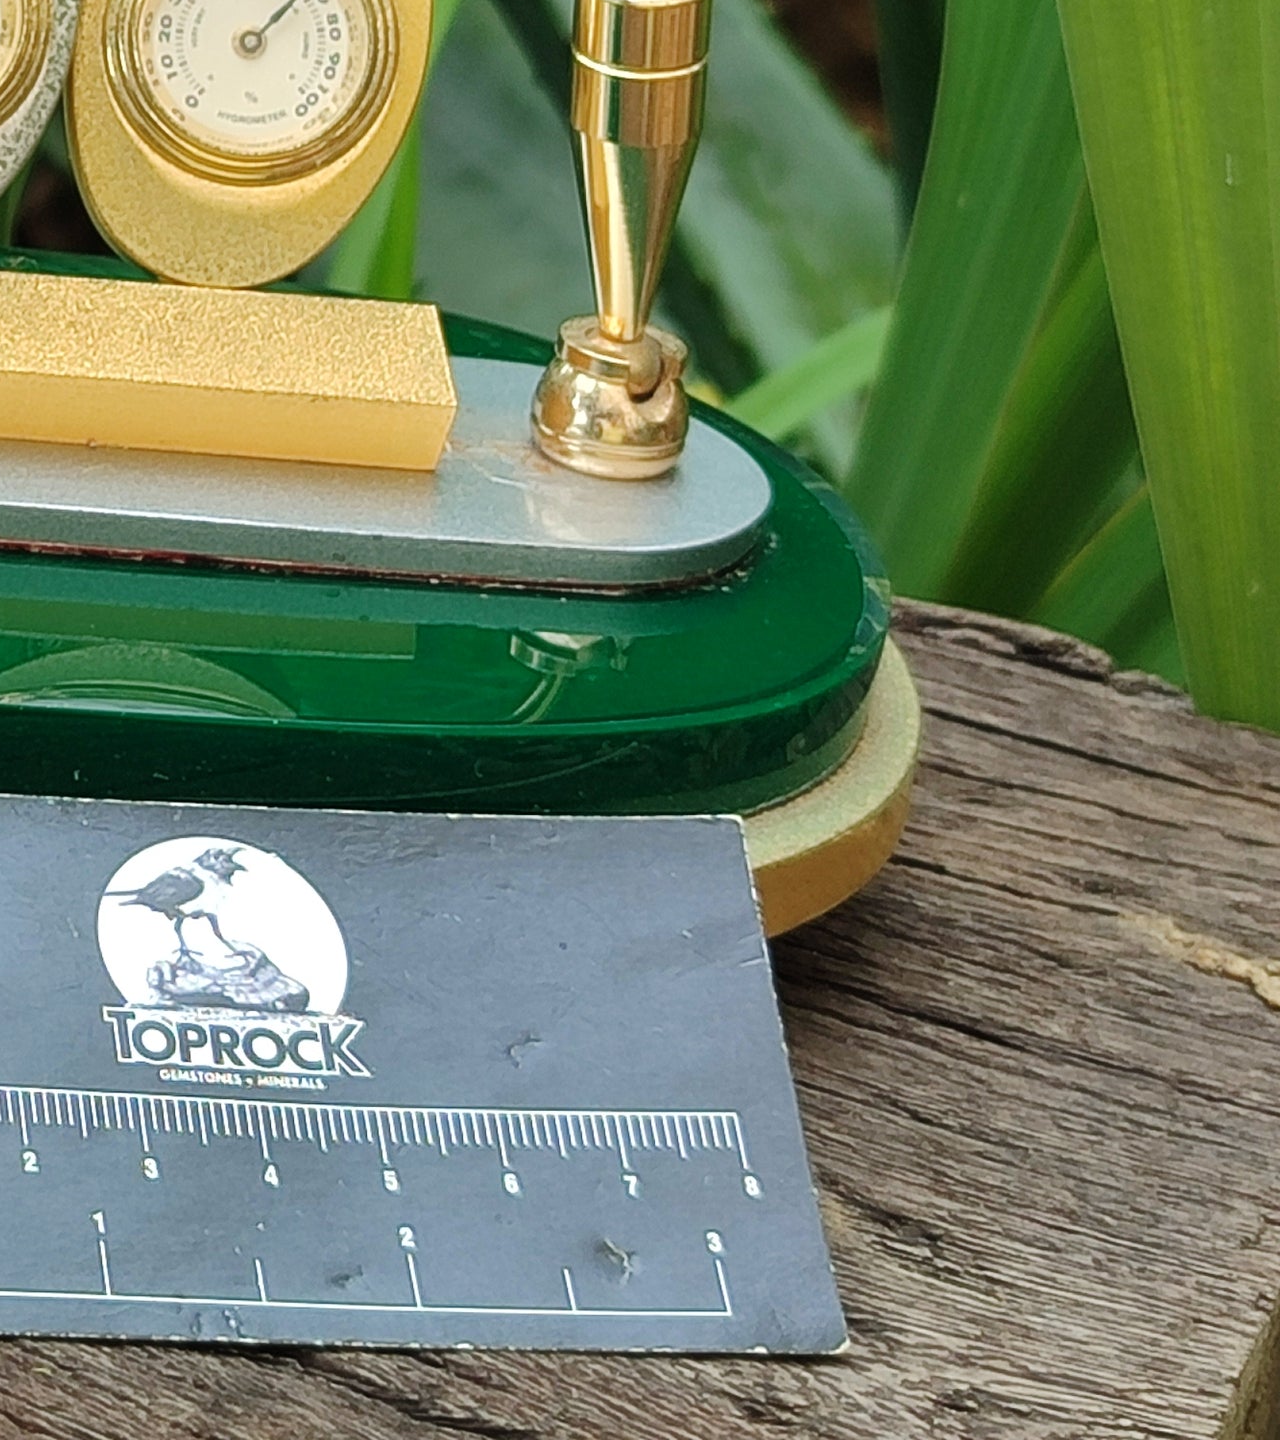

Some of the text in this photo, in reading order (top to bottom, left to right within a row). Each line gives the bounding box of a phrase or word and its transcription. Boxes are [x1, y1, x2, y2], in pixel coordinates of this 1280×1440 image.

[158, 14, 172, 43] 20
[327, 13, 341, 41] 80
[161, 54, 178, 80] 10
[324, 52, 341, 80] 90
[185, 95, 199, 108] 0
[295, 85, 329, 117] 100
[217, 110, 287, 125] HYGROMETER
[103, 1006, 371, 1076] TOPROCK
[159, 1069, 327, 1091] GEMSTONES MINERALS
[22, 1151, 40, 1173] 2
[142, 1158, 158, 1179] 3
[263, 1164, 279, 1188] 4
[383, 1169, 400, 1192] 5
[503, 1172, 519, 1194] 6
[622, 1174, 638, 1197] 7
[744, 1174, 760, 1197] 8
[91, 1211, 106, 1235] 1
[397, 1226, 415, 1249] 2
[705, 1231, 723, 1254] 3
